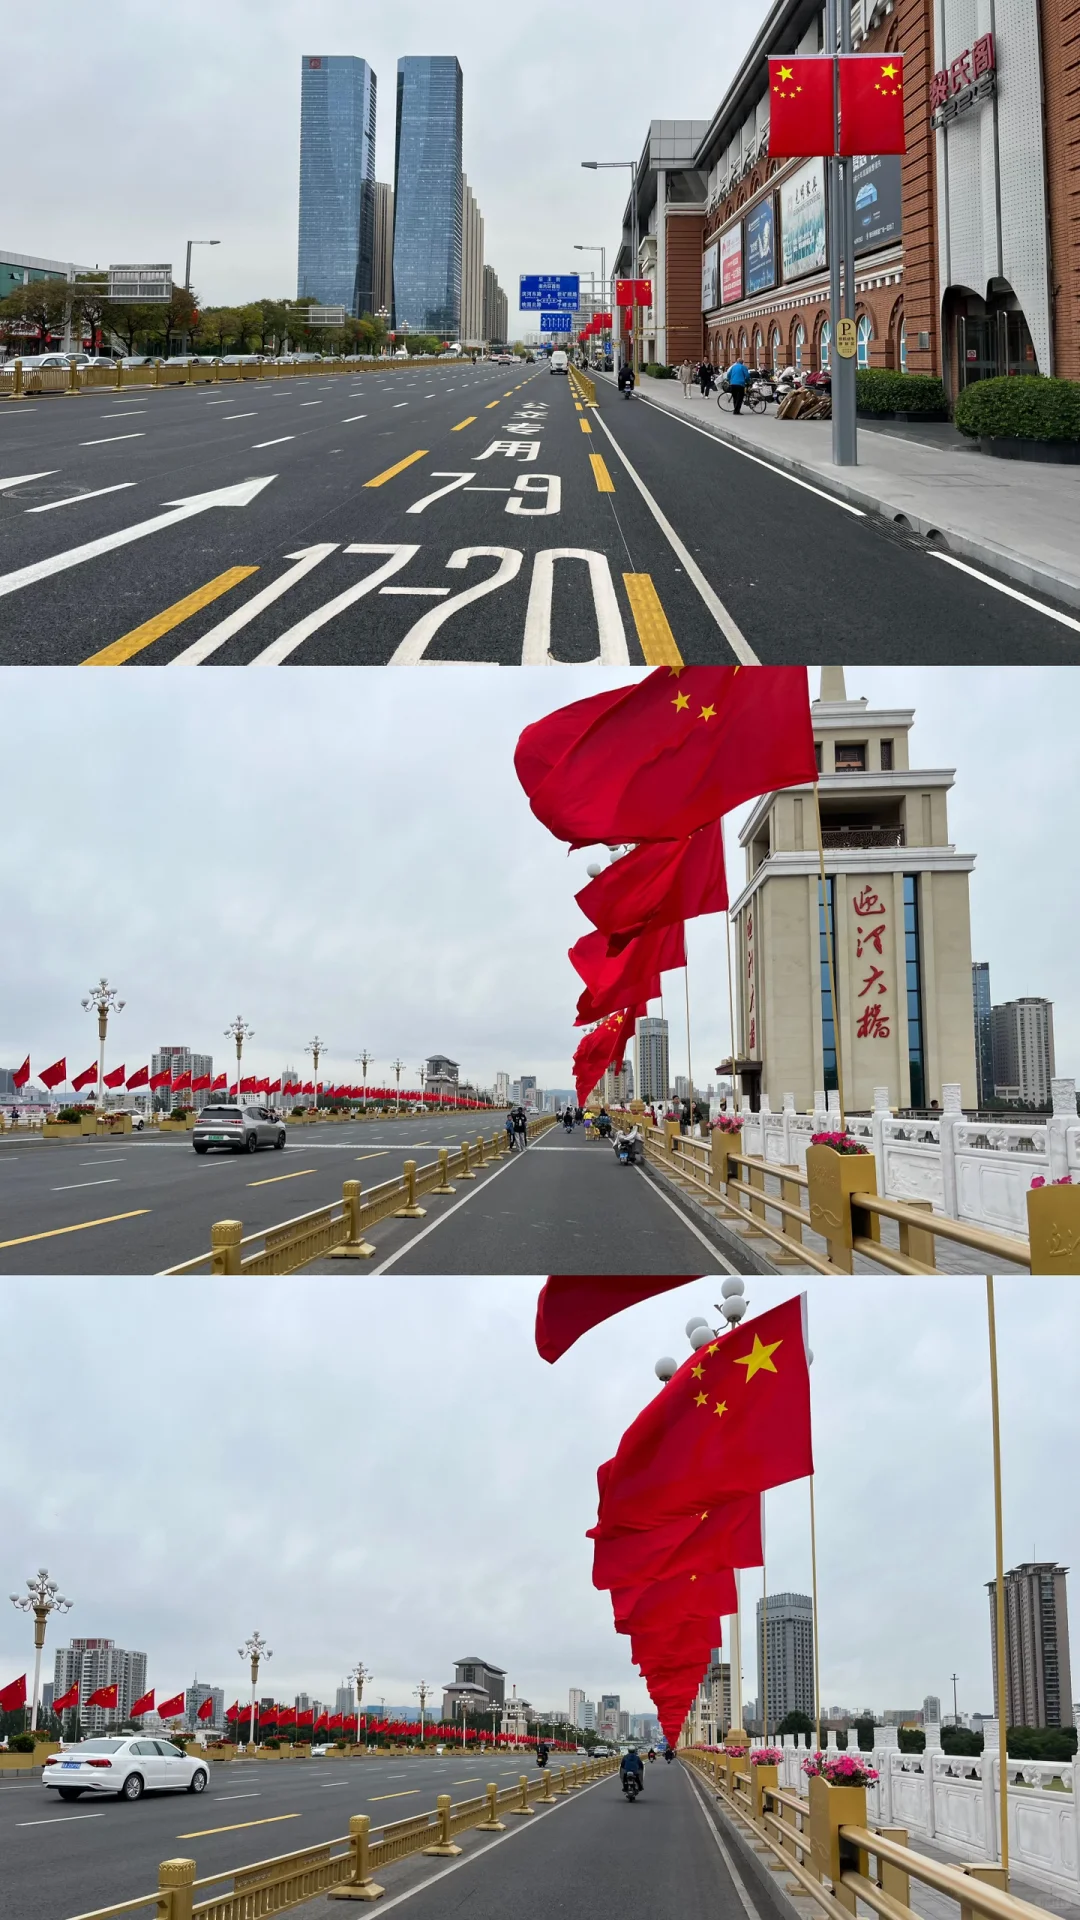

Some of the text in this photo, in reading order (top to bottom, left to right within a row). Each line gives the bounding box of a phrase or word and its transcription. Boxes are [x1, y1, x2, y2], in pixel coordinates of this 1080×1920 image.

[929, 33, 996, 113] 黎氏阁
[841, 322, 851, 335] P
[406, 472, 561, 516] 7-9
[167, 542, 631, 666] 17-20
